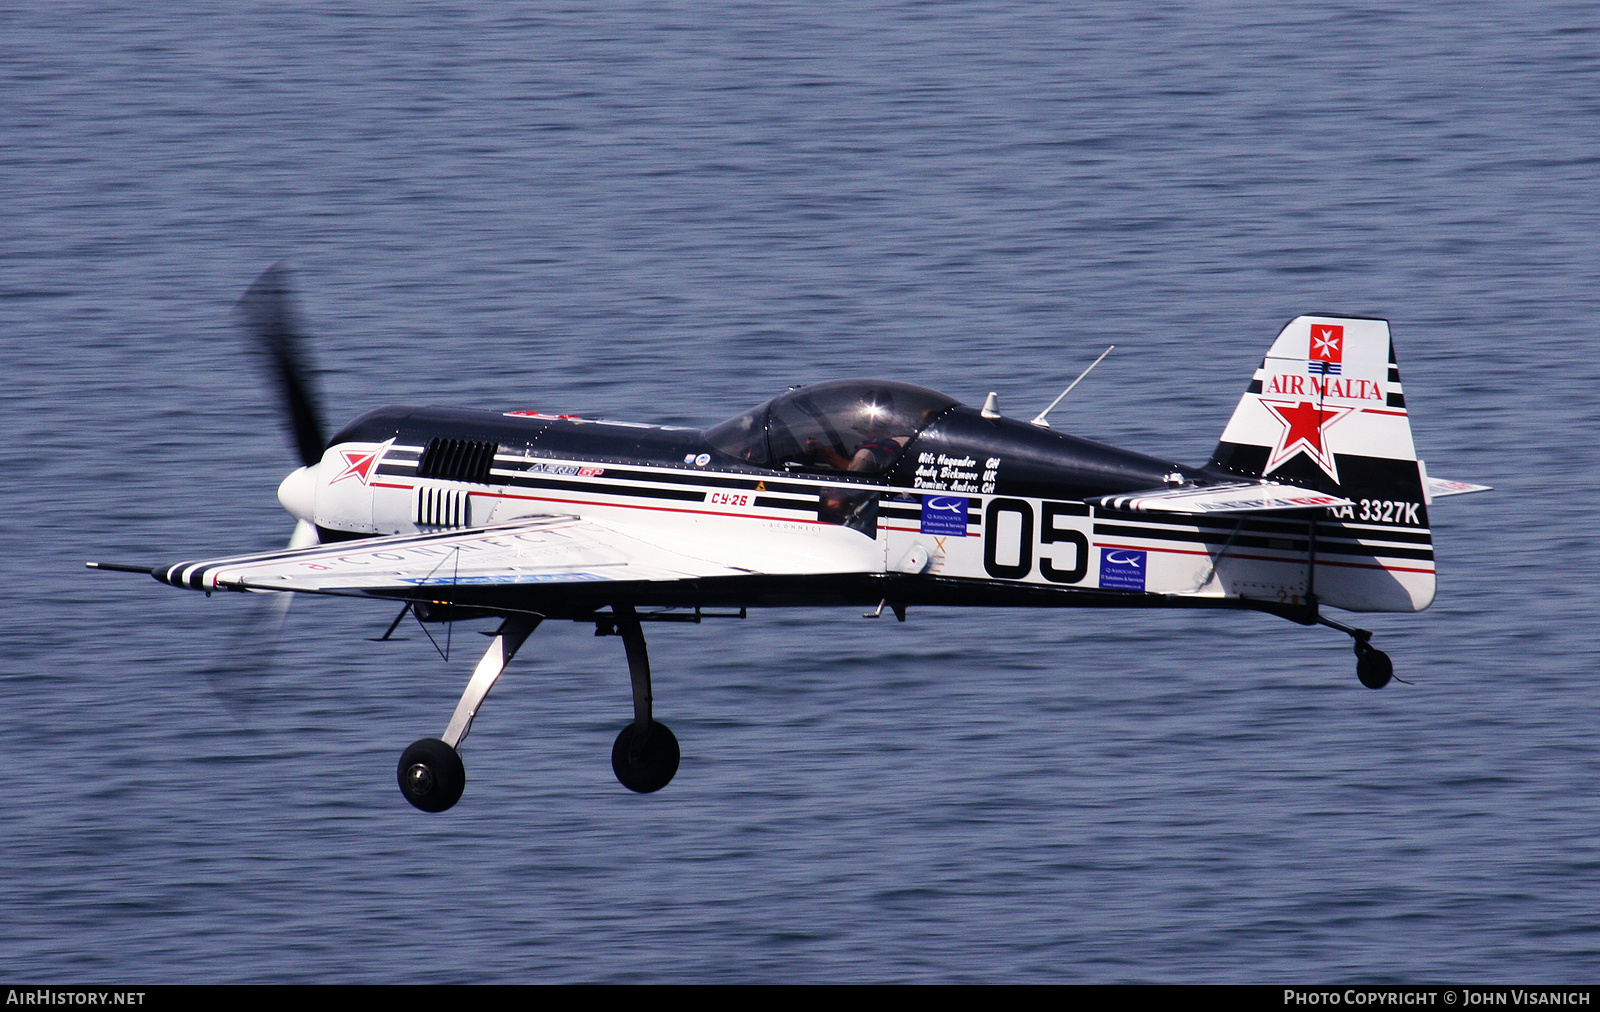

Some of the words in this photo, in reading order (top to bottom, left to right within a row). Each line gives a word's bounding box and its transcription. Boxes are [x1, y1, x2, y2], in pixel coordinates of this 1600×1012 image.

[1266, 374, 1304, 395] AIR
[1310, 376, 1383, 400] MALTA
[918, 452, 935, 464] Nils
[527, 463, 579, 476] AERO
[578, 466, 604, 477] GP
[915, 465, 938, 482] Andy
[982, 470, 997, 481] UK
[914, 477, 947, 490] Dominic
[1359, 499, 1420, 525] 3327K
[984, 497, 1090, 584] 05
